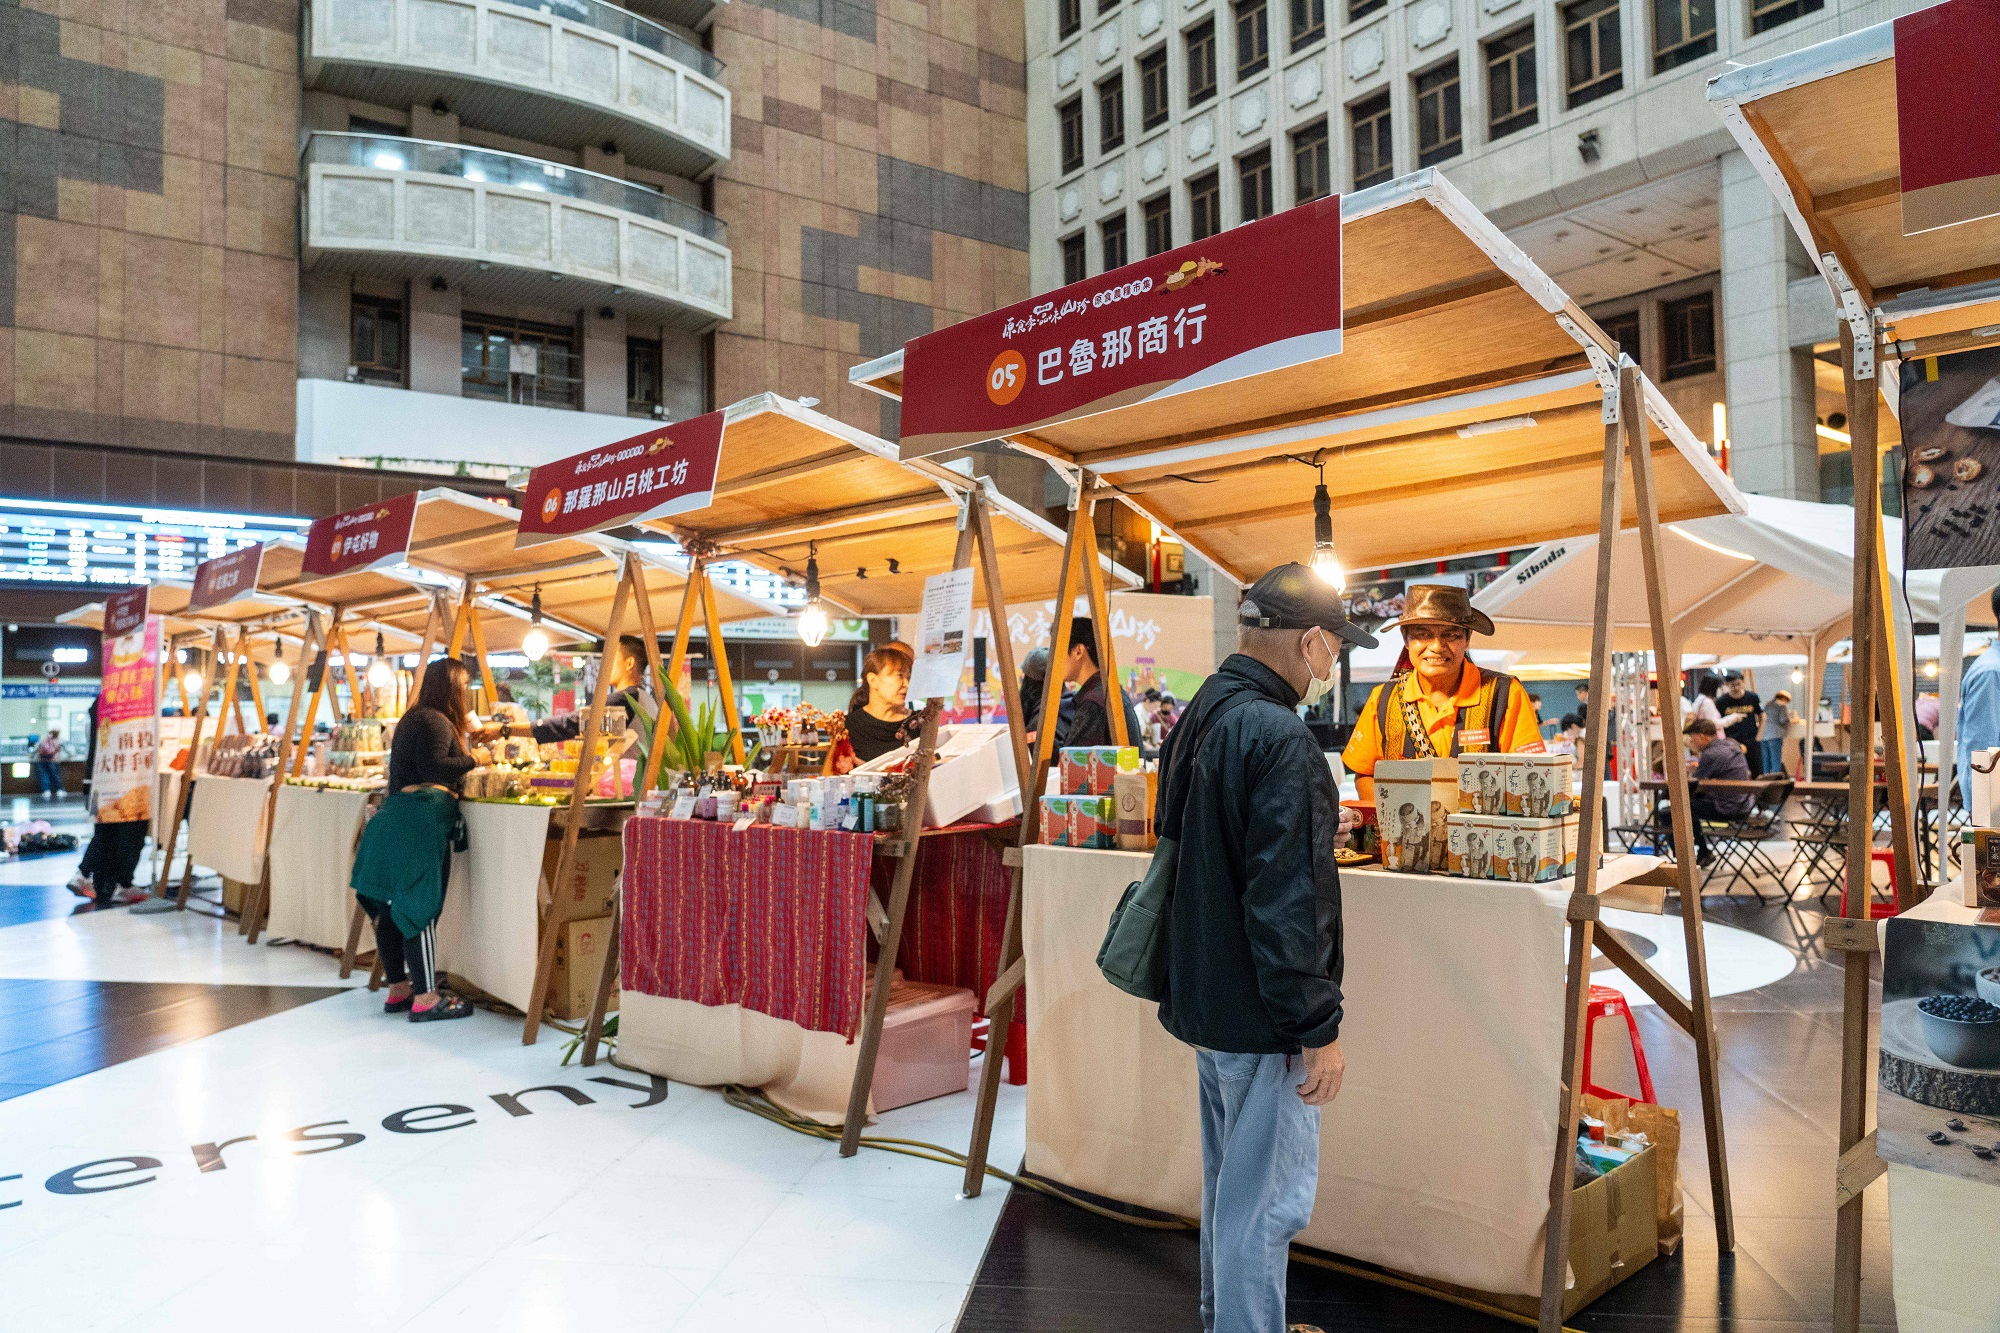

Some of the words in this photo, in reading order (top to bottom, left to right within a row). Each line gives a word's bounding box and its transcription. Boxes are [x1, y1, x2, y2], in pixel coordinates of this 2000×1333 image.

[991, 363, 1019, 390] 05
[1038, 303, 1208, 386] 巴魯那商行
[544, 496, 558, 514] 06
[563, 458, 689, 515] 那羅那山月桃工坊
